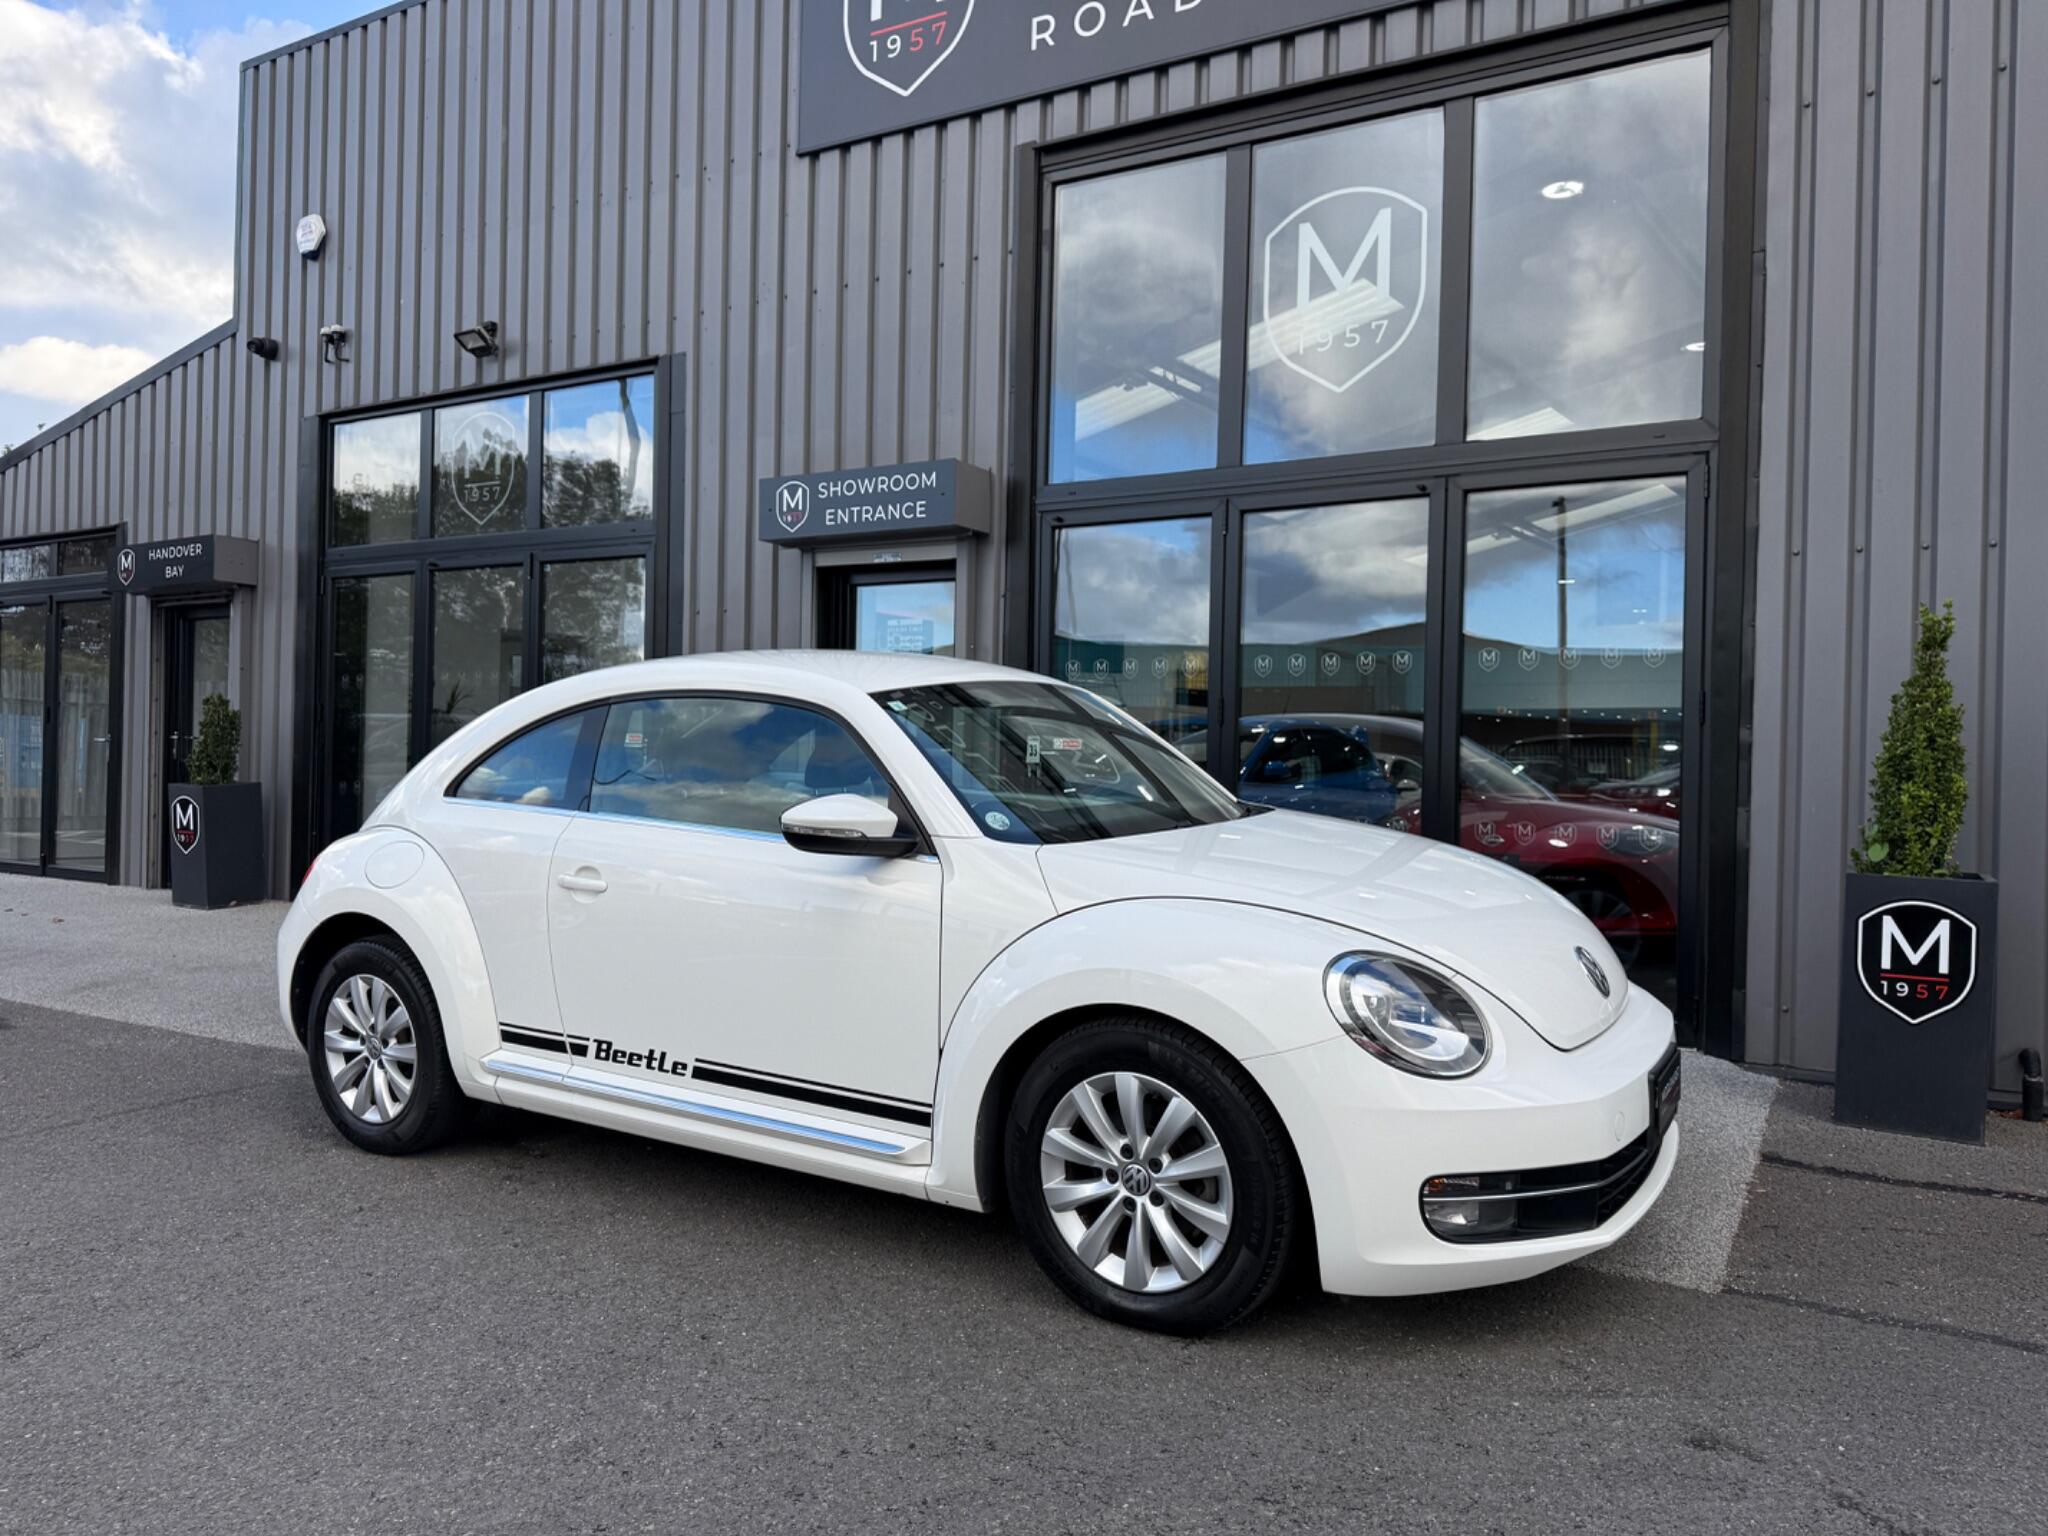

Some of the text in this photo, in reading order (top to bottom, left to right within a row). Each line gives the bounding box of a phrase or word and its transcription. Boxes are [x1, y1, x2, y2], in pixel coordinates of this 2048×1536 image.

[869, 20, 947, 62] 1957
[1297, 207, 1392, 311] M
[1299, 319, 1388, 355] 1957
[464, 486, 500, 503] 1957
[818, 471, 936, 499] SHOWROOM
[783, 487, 803, 512] M
[825, 501, 927, 526] ENTRANCE
[121, 553, 132, 571] M
[149, 543, 202, 560] HANDOVER
[166, 565, 184, 578] BAY
[176, 803, 193, 830] M
[1881, 915, 1950, 974] M
[1880, 980, 1948, 1000] 1957
[592, 1038, 688, 1077] Beetle
